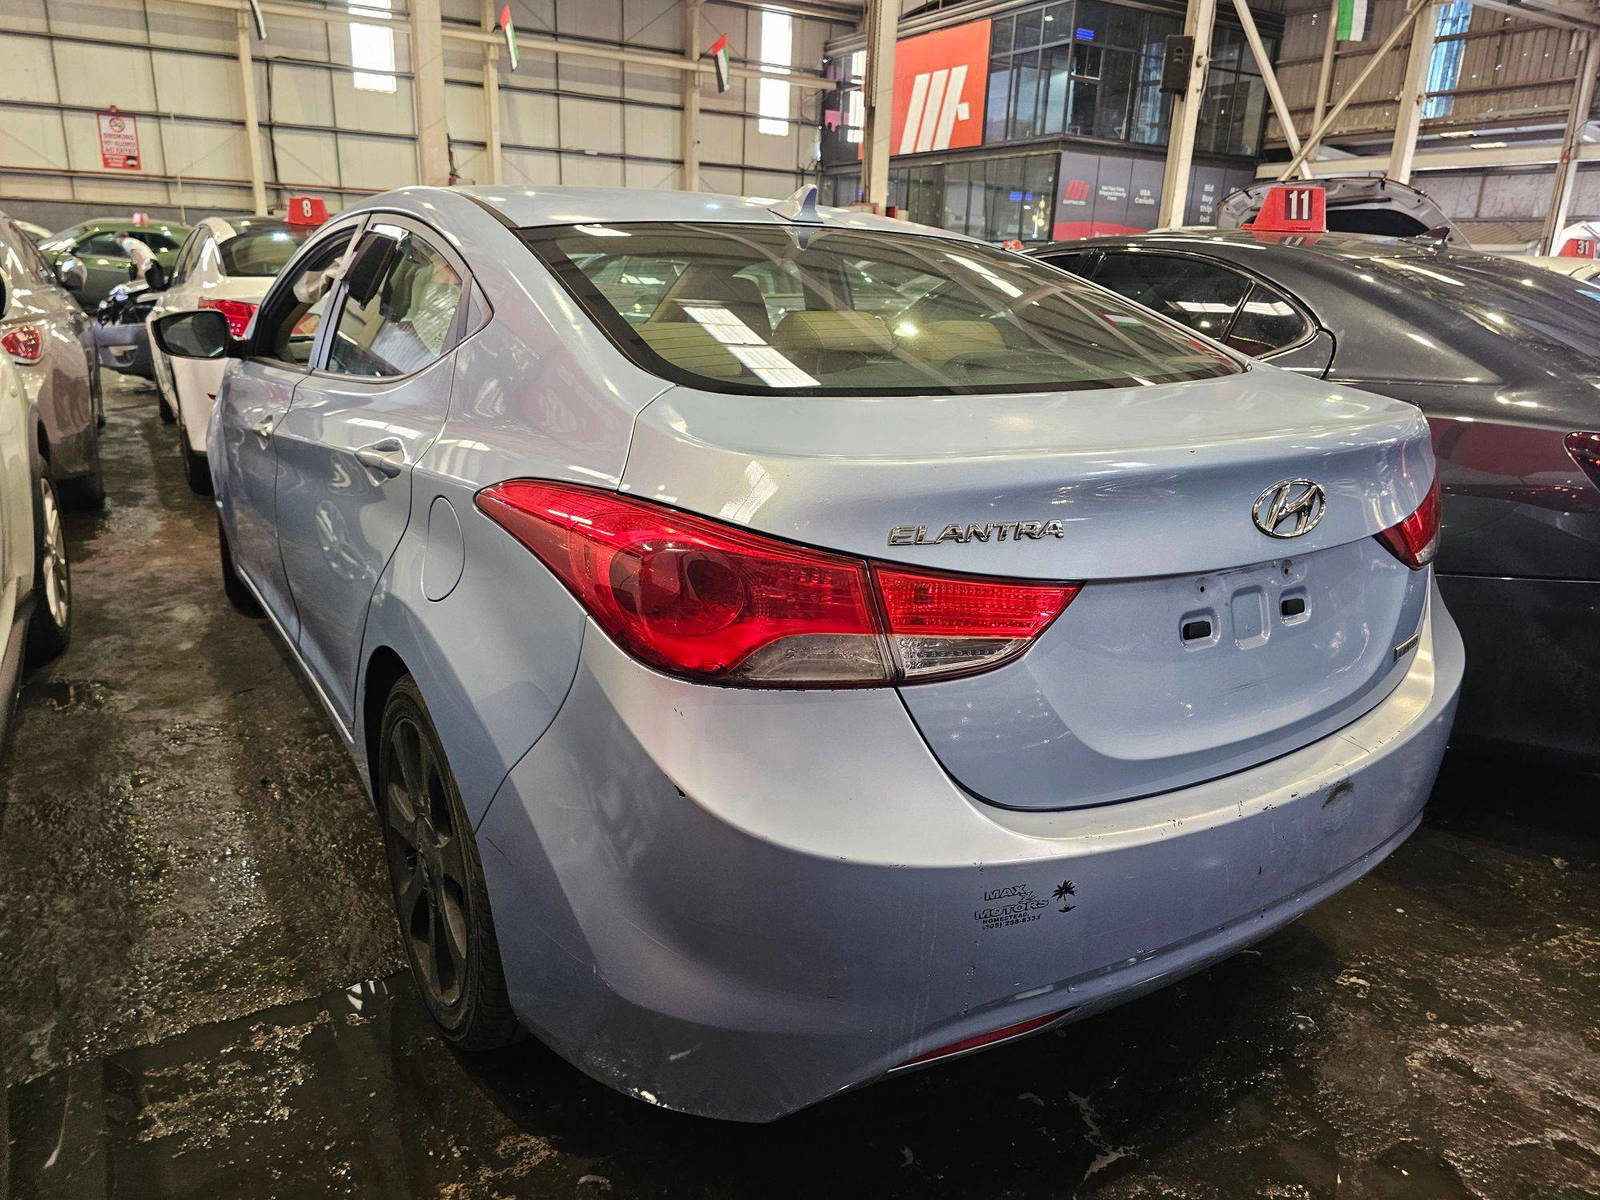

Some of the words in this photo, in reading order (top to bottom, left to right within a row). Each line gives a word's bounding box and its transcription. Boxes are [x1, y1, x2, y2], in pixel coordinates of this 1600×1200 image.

[302, 199, 312, 218] 8
[1289, 190, 1310, 220] 11
[1577, 240, 1590, 255] 31
[888, 519, 1065, 546] ELANTRA
[984, 884, 1027, 901] MAX
[974, 900, 1049, 920] MOTORS
